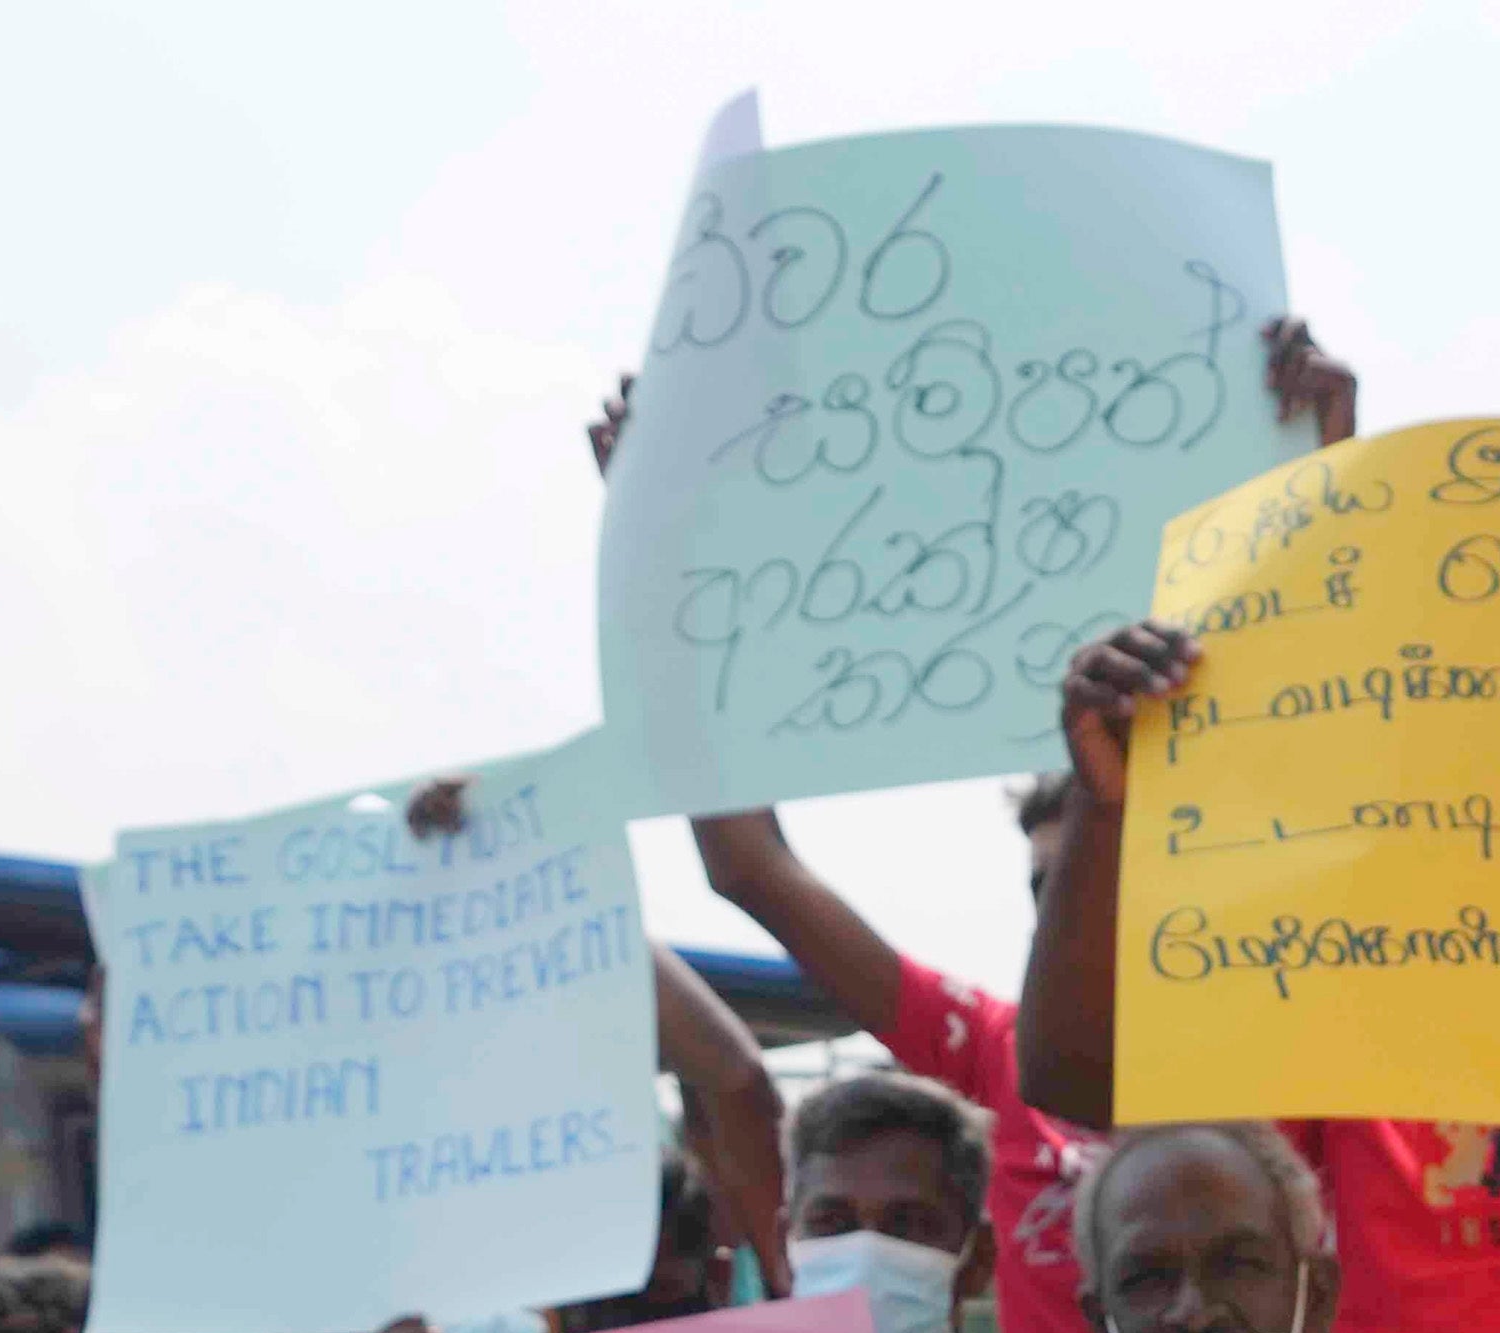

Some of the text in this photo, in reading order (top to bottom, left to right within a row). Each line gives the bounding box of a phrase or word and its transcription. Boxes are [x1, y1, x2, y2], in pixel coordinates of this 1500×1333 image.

[122, 845, 590, 968] TAKE IMMEDIATE
[128, 836, 250, 894] THE
[276, 820, 418, 884] GOSL
[127, 904, 634, 1047] ACTION TO PREVENT
[176, 1054, 382, 1136] INDIAN
